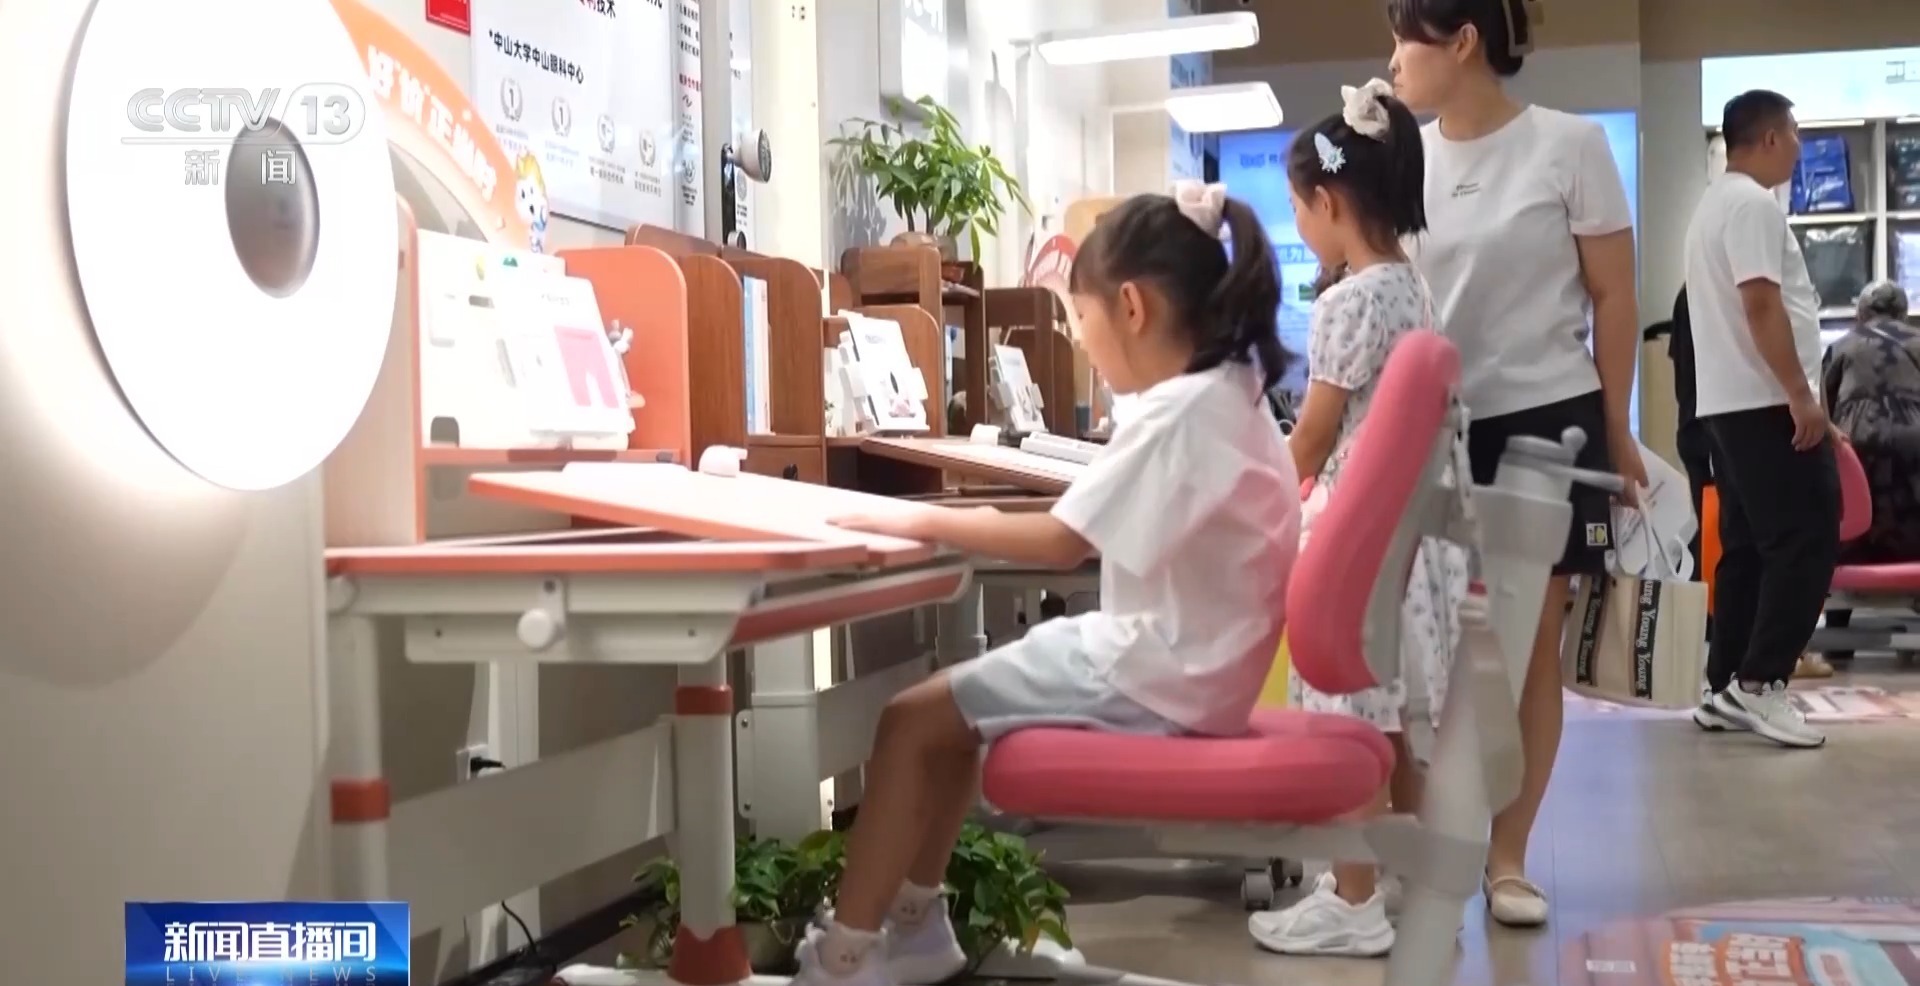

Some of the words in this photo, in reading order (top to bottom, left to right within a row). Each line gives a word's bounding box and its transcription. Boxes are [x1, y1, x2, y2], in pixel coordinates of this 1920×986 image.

[493, 31, 584, 85] 中山大学中山眼科中心
[1636, 608, 1656, 648] Young
[1636, 651, 1651, 690] Young
